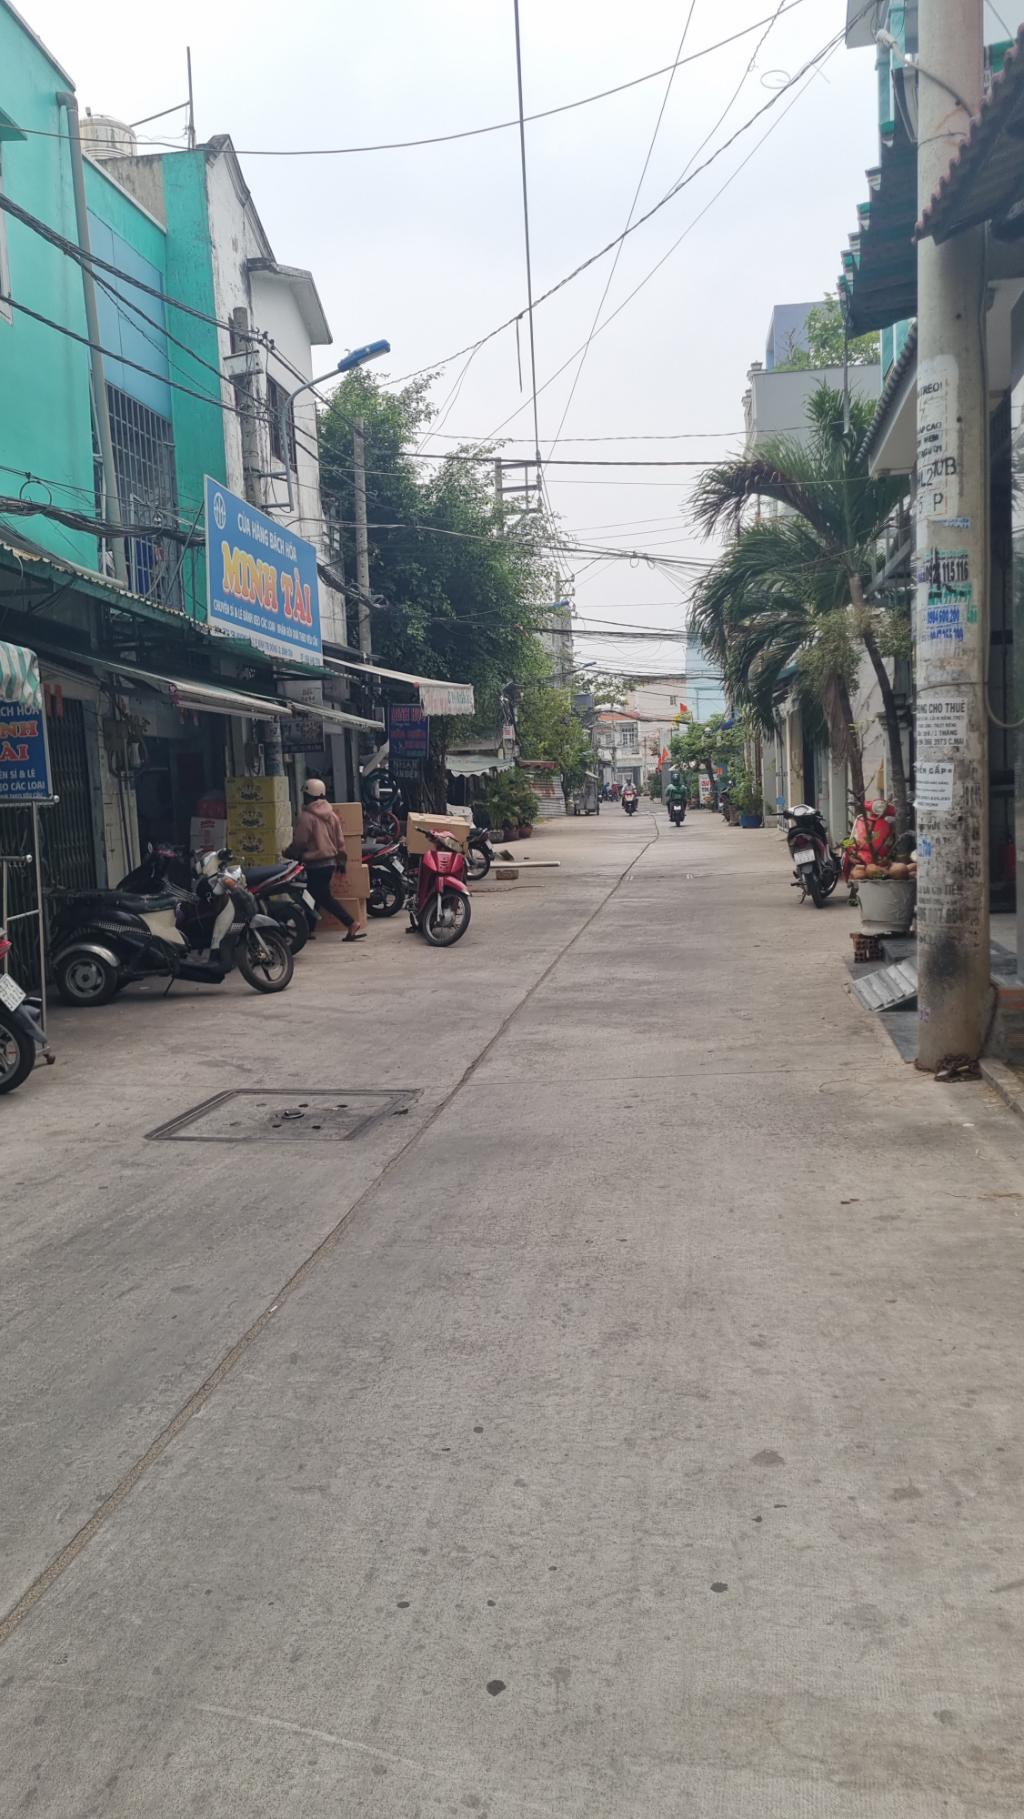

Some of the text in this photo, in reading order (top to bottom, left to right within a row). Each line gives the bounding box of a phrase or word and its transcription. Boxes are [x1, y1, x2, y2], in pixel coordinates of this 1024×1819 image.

[221, 540, 313, 626] MINH TÀI
[929, 703, 943, 714] CHO
[945, 700, 966, 713] THUÊ
[929, 764, 946, 774] GẤP
[11, 780, 26, 791] CÁC
